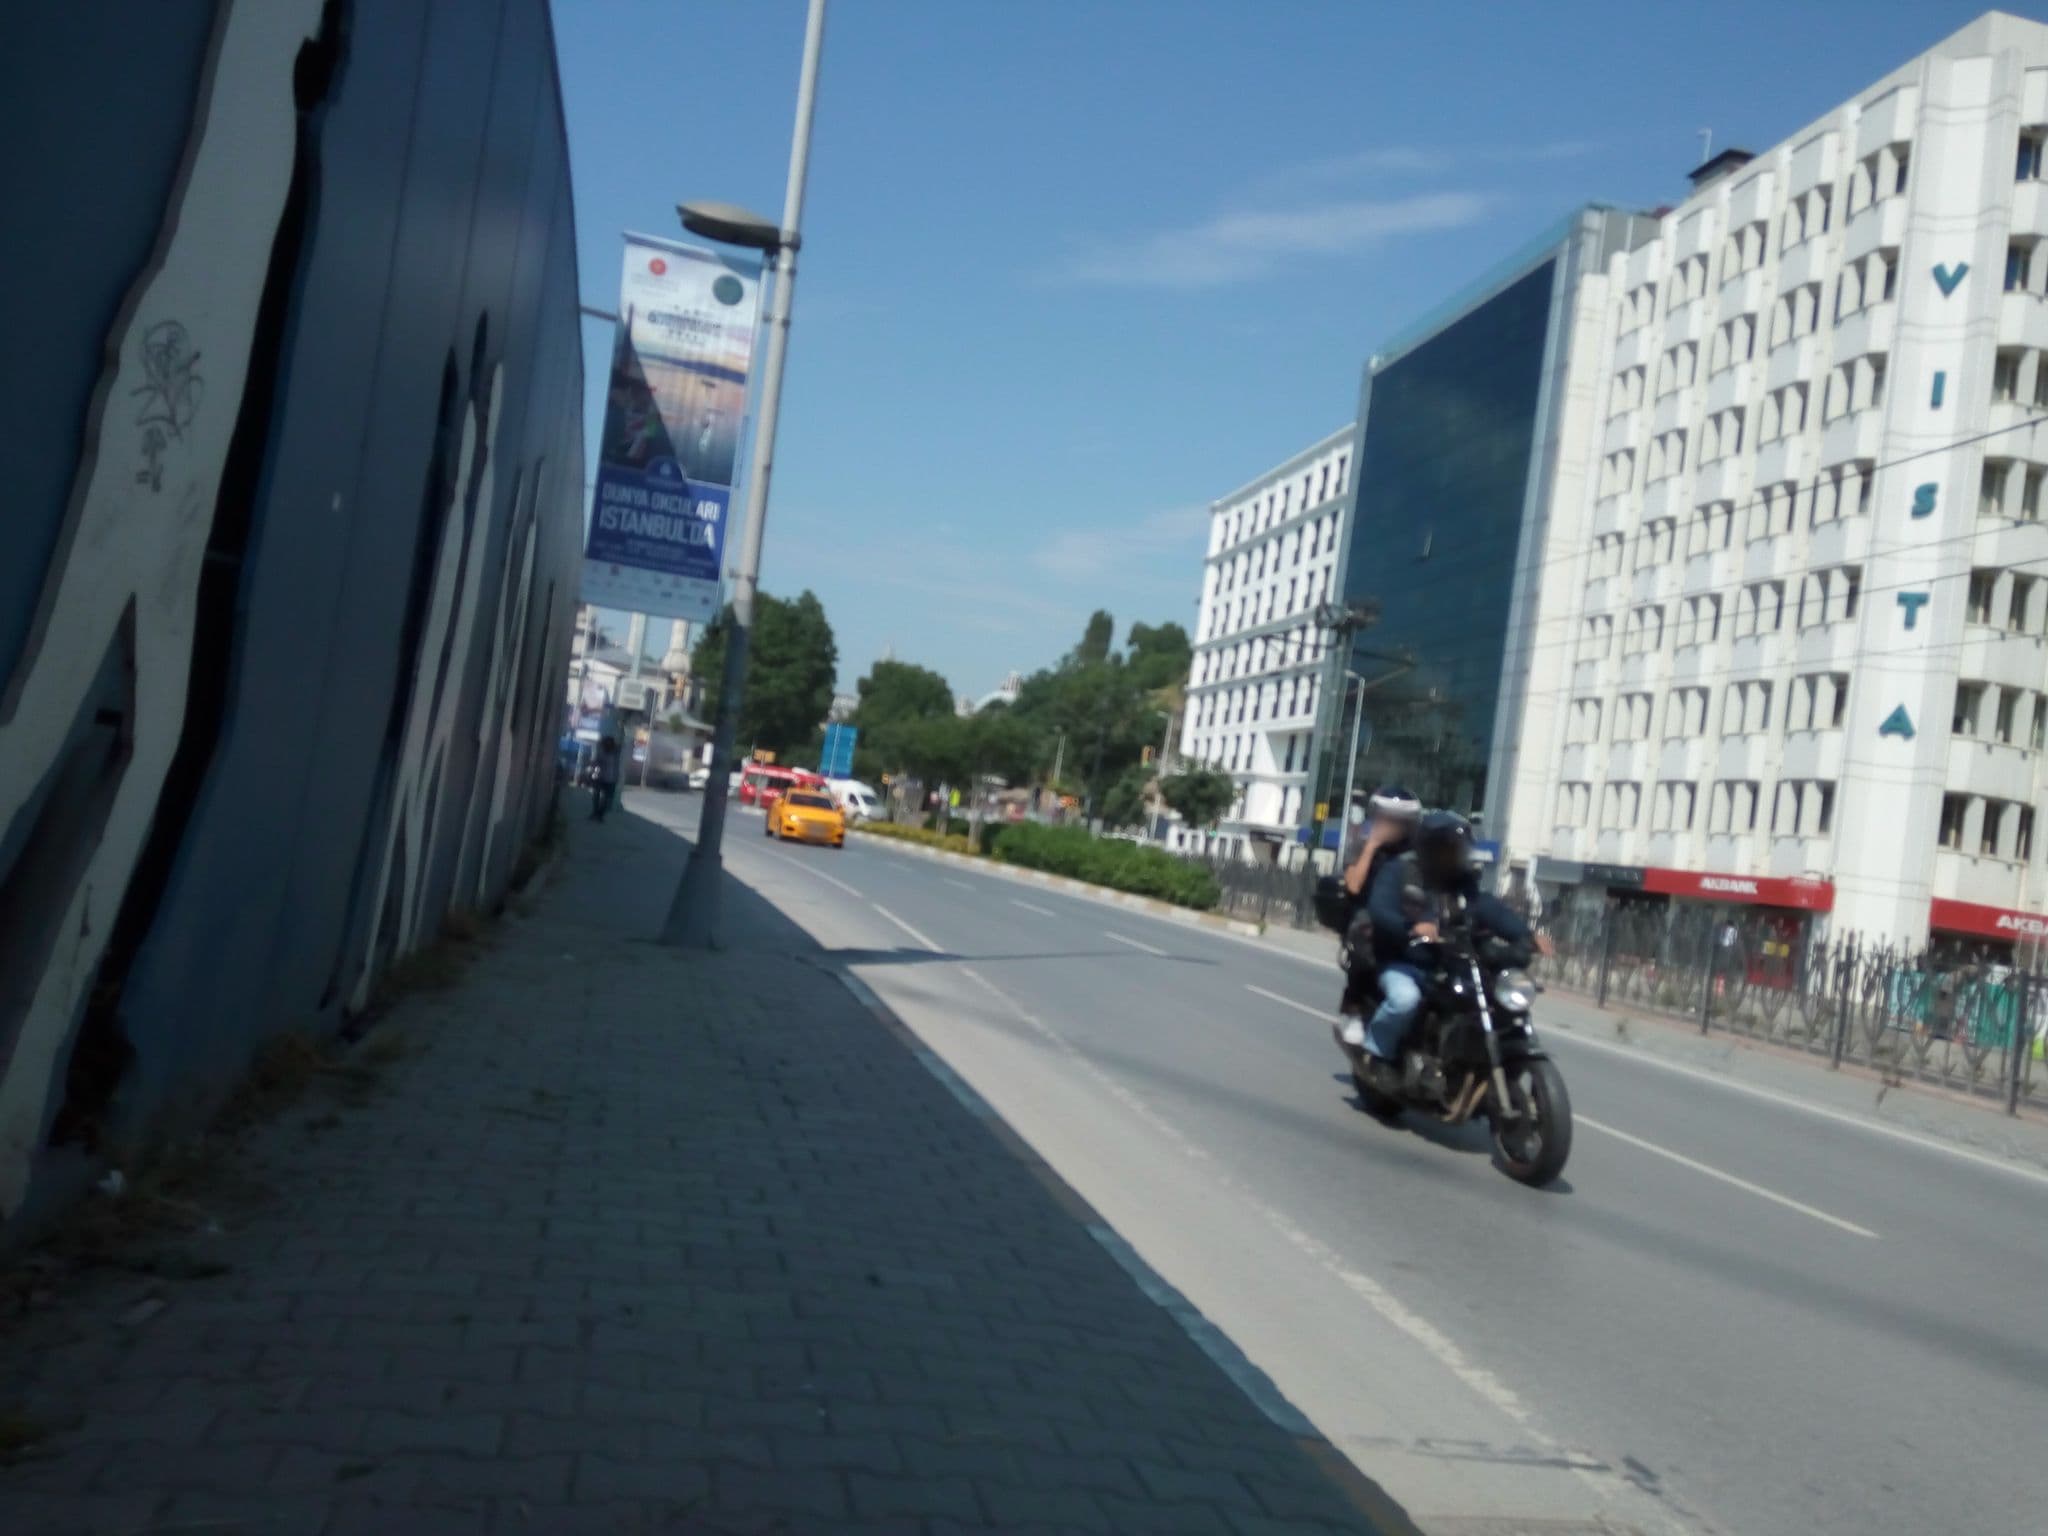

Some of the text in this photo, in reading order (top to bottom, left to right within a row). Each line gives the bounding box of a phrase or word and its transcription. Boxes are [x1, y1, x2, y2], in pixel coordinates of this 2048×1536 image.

[1878, 261, 1970, 741] VISTA
[1700, 876, 1758, 895] AKBANK
[1995, 914, 2048, 936] AKB
